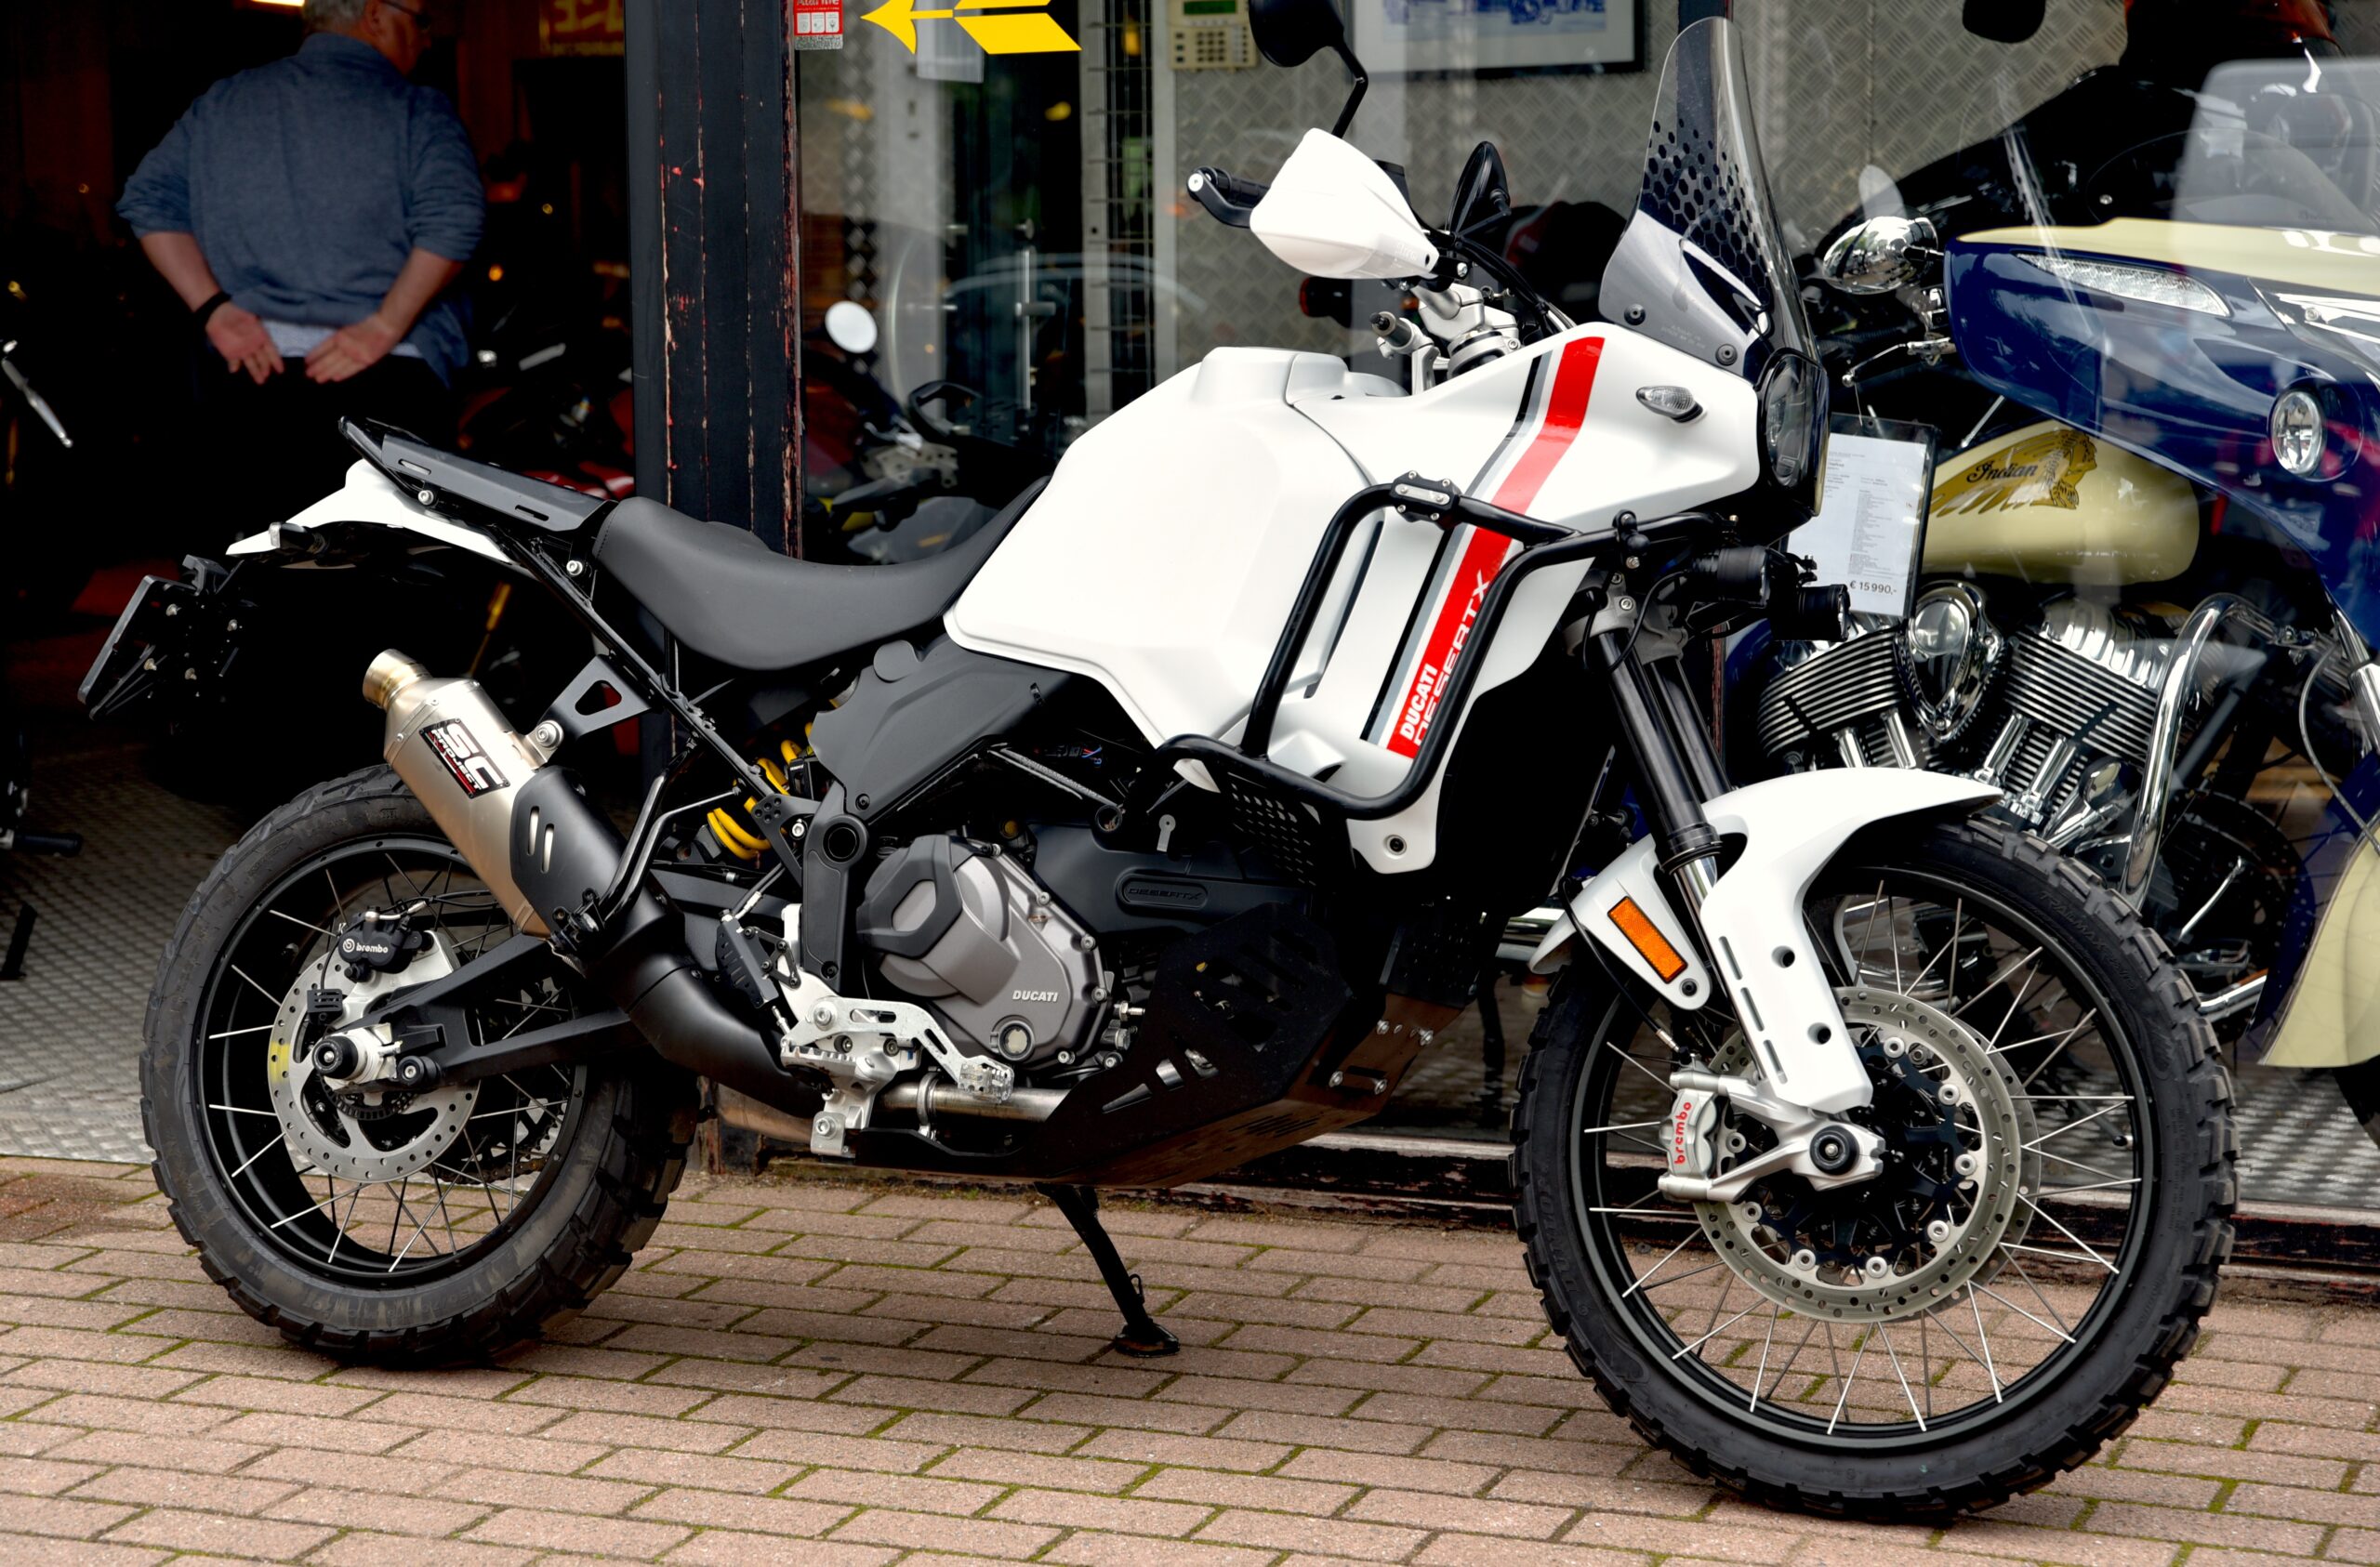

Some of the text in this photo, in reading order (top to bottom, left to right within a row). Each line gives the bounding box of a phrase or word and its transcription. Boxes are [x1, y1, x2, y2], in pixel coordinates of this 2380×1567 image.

[1966, 459, 2039, 484] Indian
[1399, 663, 1438, 740] DUCATI
[430, 727, 483, 791] PROJECT
[446, 723, 504, 789] SC
[356, 942, 389, 954] brembo
[1012, 989, 1059, 1003] DUCATI
[1673, 1101, 1692, 1165] brembo
